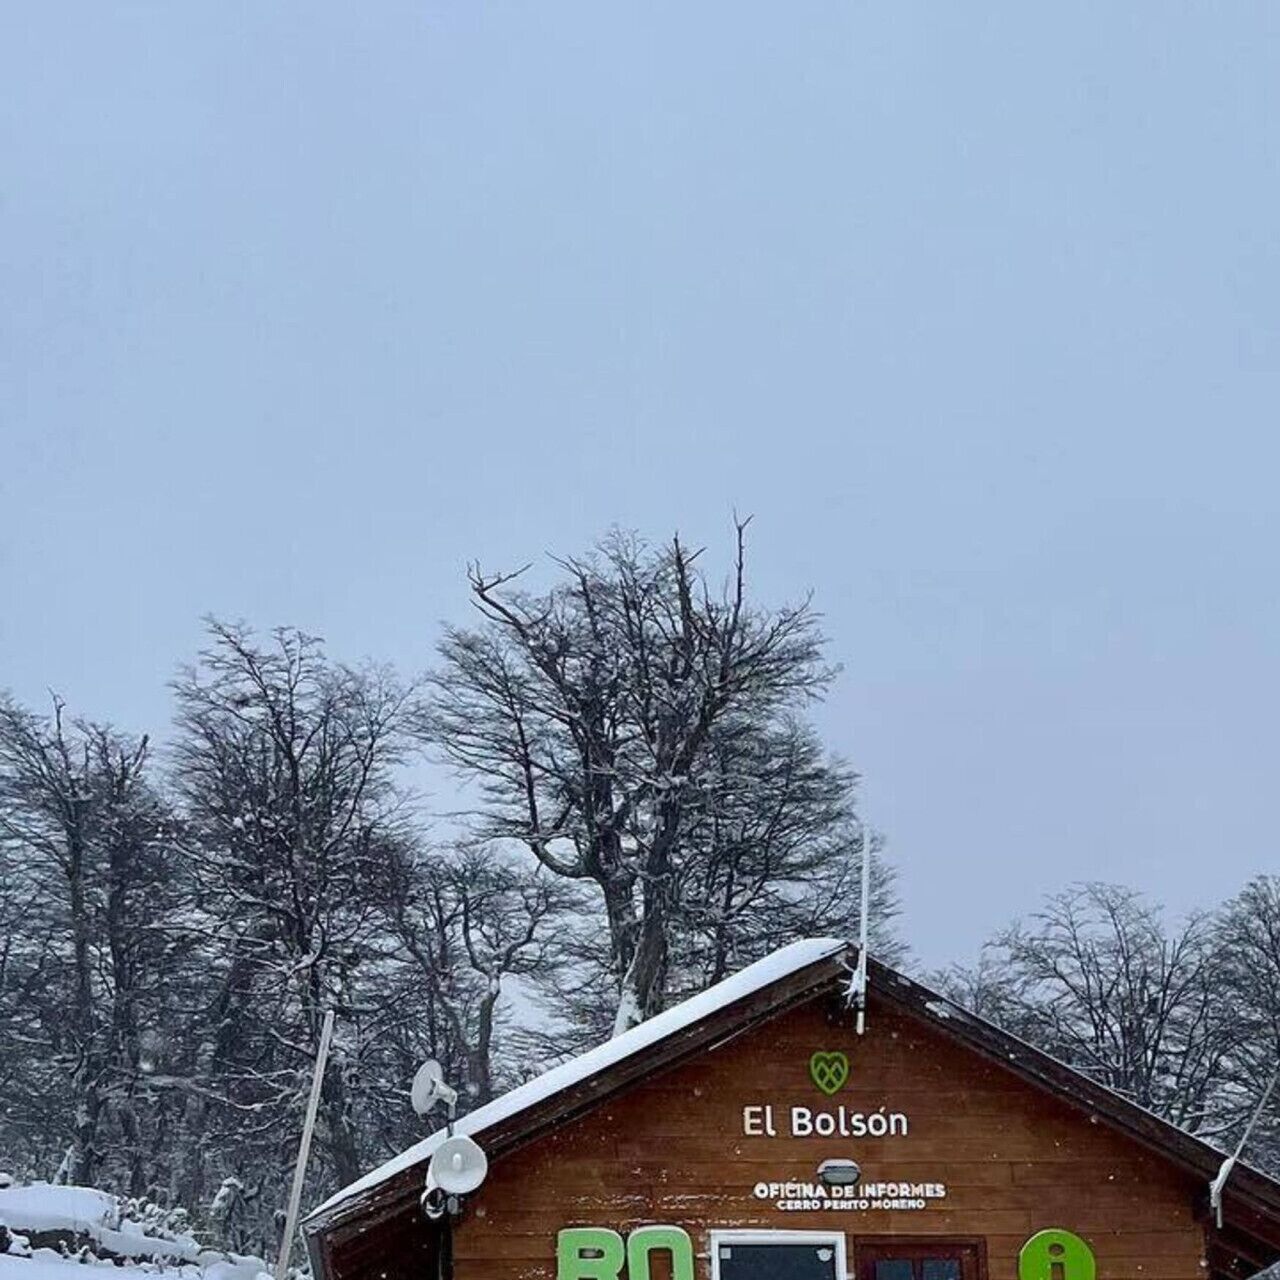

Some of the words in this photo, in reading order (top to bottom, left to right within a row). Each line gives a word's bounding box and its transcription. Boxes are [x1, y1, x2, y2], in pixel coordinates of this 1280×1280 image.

[743, 1105, 776, 1136] El
[791, 1105, 908, 1136] Bolsón
[754, 1182, 828, 1198] OFICINA
[831, 1185, 855, 1197] DE
[859, 1183, 946, 1198] INFORMES
[776, 1200, 820, 1210] CERRO
[823, 1200, 869, 1210] PERITO
[871, 1199, 926, 1210] MORENO
